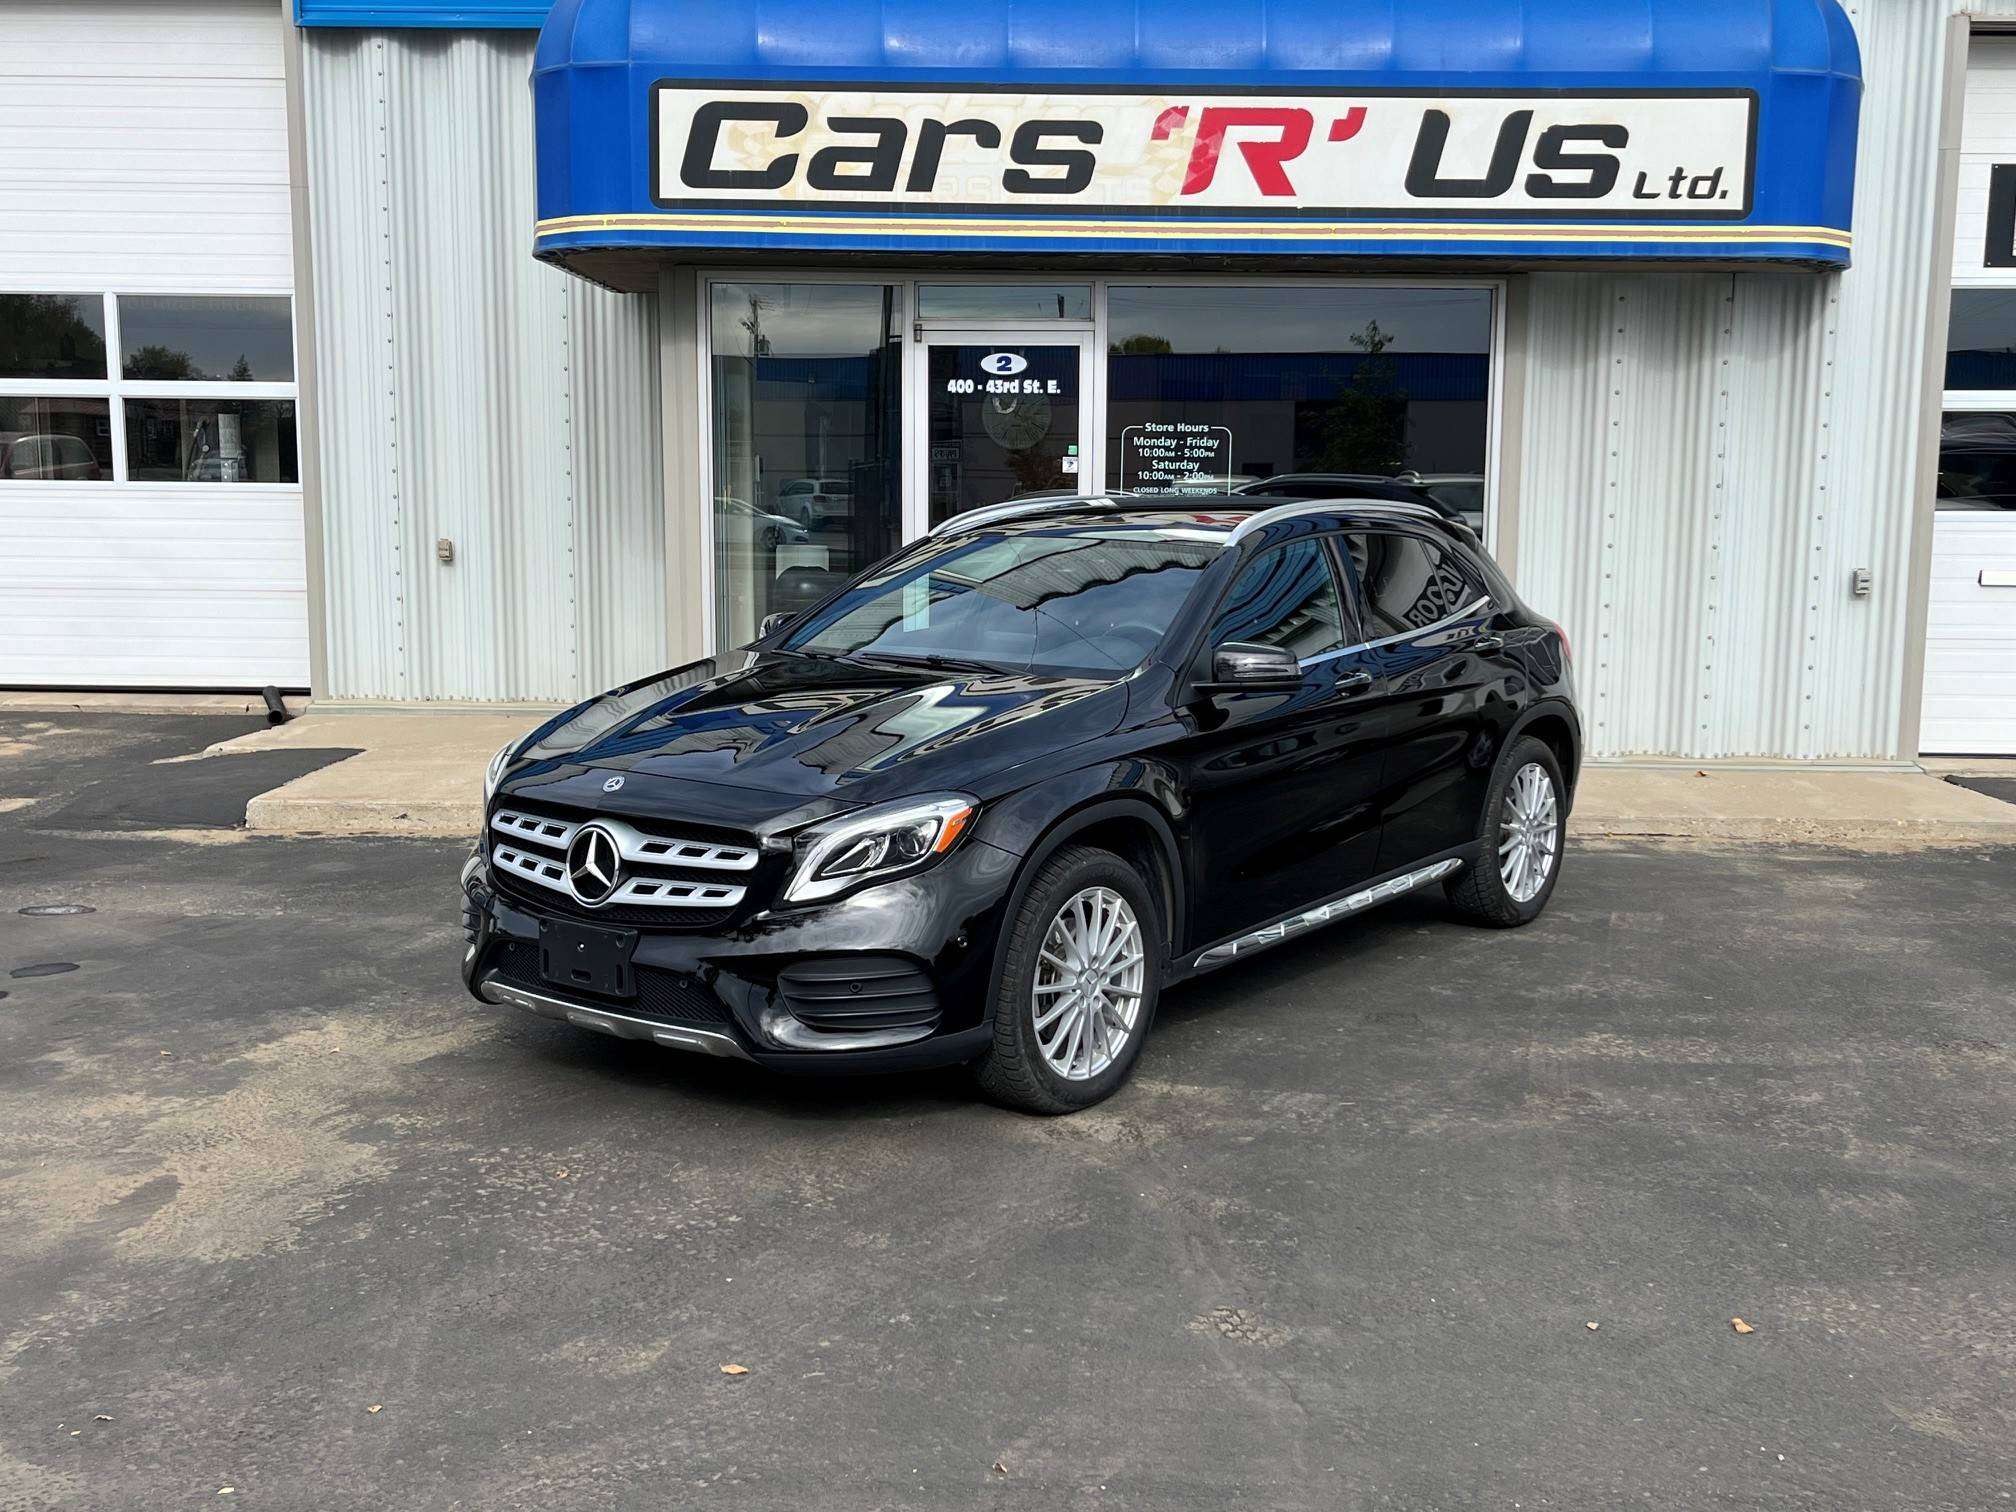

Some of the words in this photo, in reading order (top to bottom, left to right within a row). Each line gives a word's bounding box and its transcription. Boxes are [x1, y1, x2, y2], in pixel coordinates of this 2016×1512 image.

[680, 100, 1104, 195] Cars
[1404, 109, 1630, 199] Us
[1632, 165, 1729, 200] Ltd.
[996, 355, 1012, 372] 2
[947, 379, 975, 394] 400
[985, 379, 1020, 394] 43rd
[1023, 379, 1044, 394] St.
[1047, 380, 1061, 394] E.
[1145, 422, 1175, 432] Store
[1177, 423, 1209, 433] Hours
[1133, 436, 1178, 449] Monday
[1186, 437, 1220, 449] Friday
[1138, 448, 1176, 457] 10:00AM
[1184, 448, 1215, 458] 5:00PM
[1152, 460, 1200, 472] Saturday
[1137, 471, 1175, 480] 10:00AM
[1133, 486, 1159, 494] CLOSED
[1160, 487, 1180, 496] LONG
[1181, 487, 1218, 496] WEEKENDS
